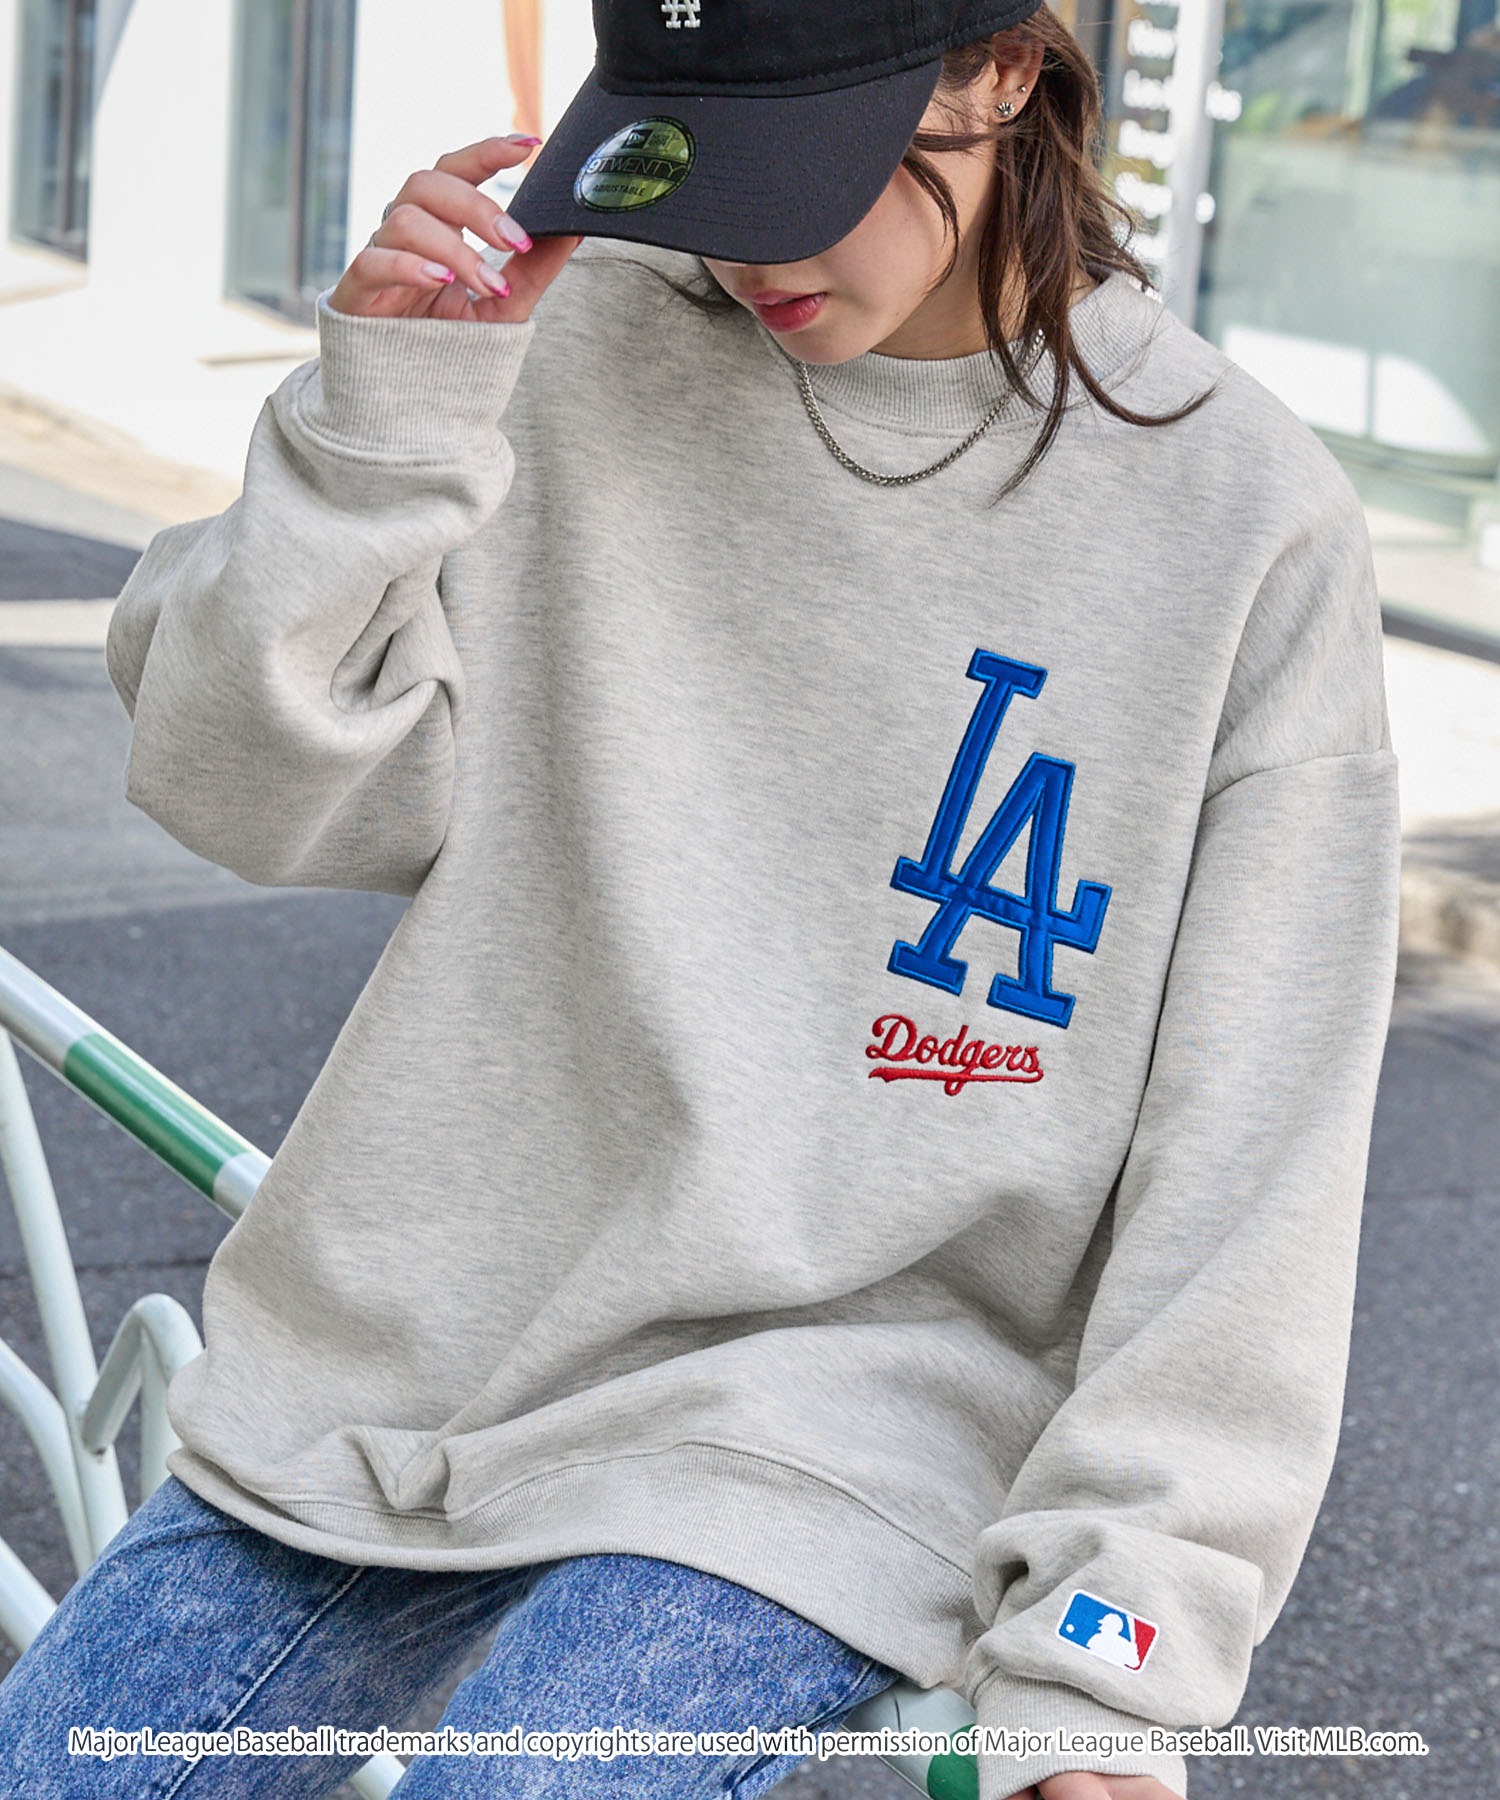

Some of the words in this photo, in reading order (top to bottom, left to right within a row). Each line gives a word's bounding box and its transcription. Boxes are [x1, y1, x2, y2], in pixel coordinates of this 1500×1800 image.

[586, 156, 687, 179] 9TWENTY
[592, 184, 648, 197] ADJUSTABLE
[887, 648, 1112, 1029] LA
[865, 1014, 1044, 1096] Dodgers
